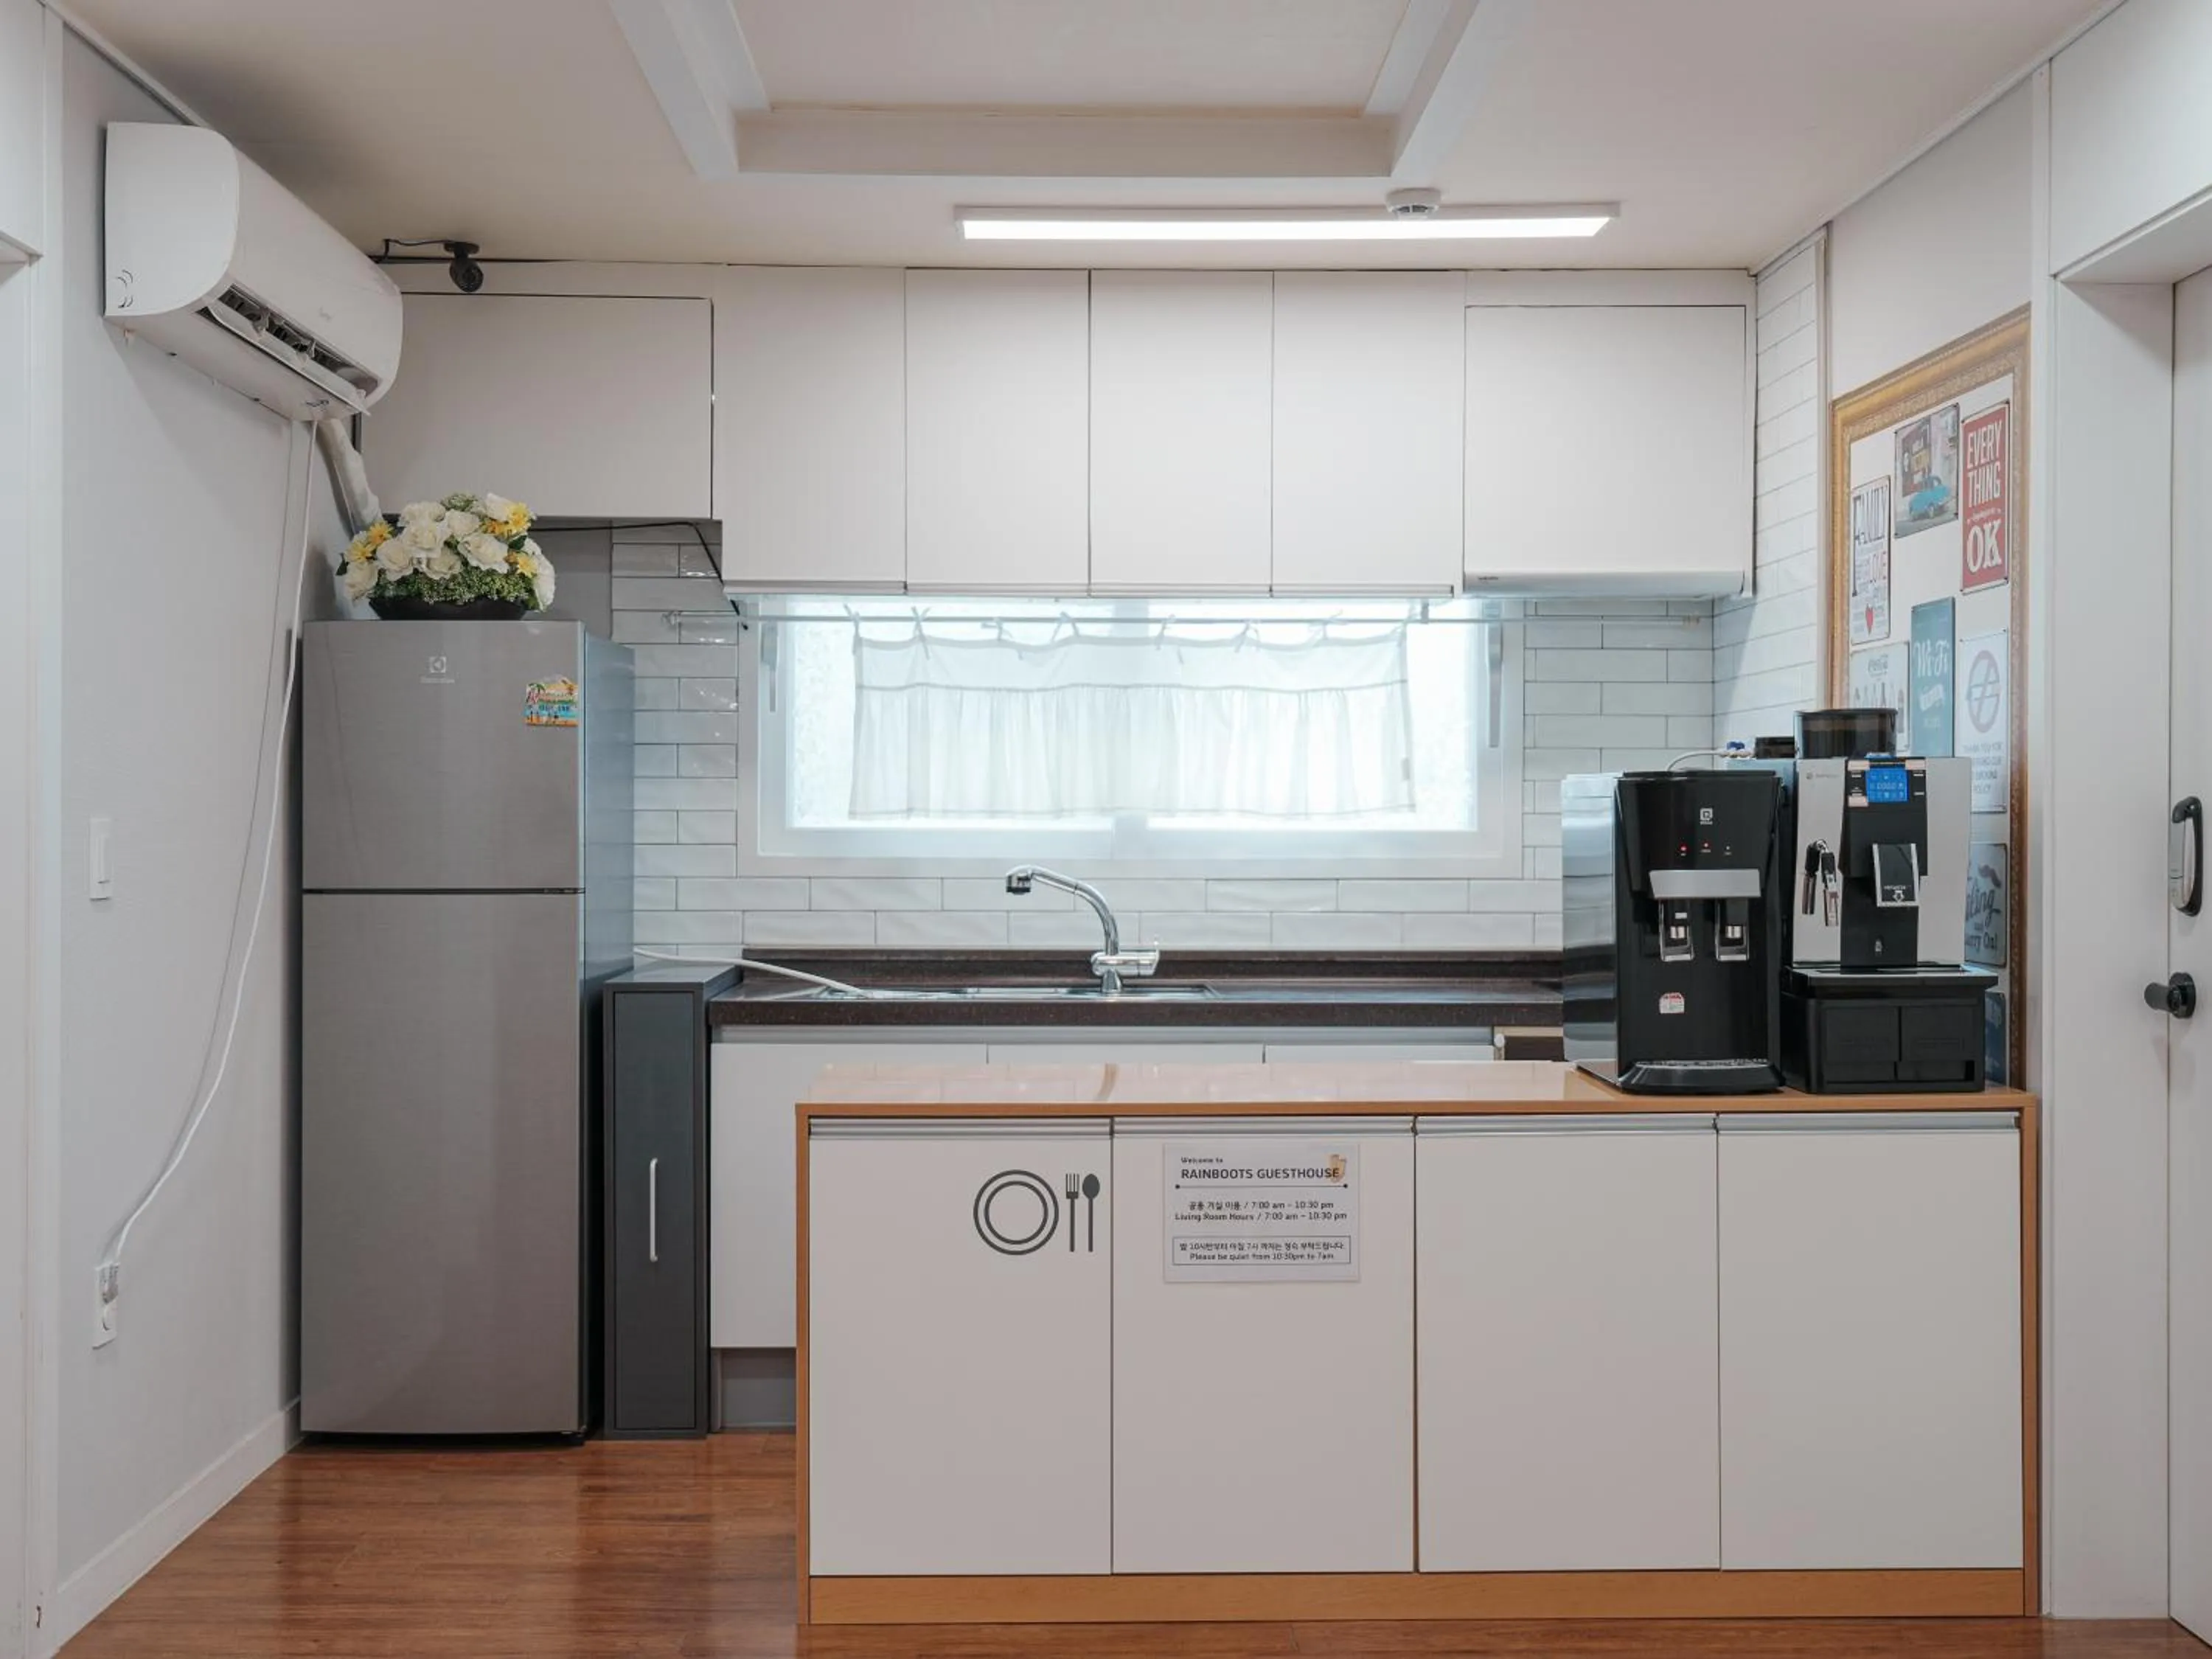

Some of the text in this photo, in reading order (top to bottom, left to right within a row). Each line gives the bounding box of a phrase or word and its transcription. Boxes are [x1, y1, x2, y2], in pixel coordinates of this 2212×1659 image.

[1966, 420, 2002, 469] EVERY
[1968, 462, 2000, 508] THING
[1967, 519, 2002, 573] OK
[1181, 1167, 1339, 1179] RAINBOOTS GUESTHOUSE
[1175, 1213, 1201, 1222] Living
[1265, 1212, 1283, 1220] 7:00
[1309, 1212, 1332, 1220] 10:30
[1334, 1213, 1347, 1221] pm
[1295, 1201, 1319, 1209] 10:30
